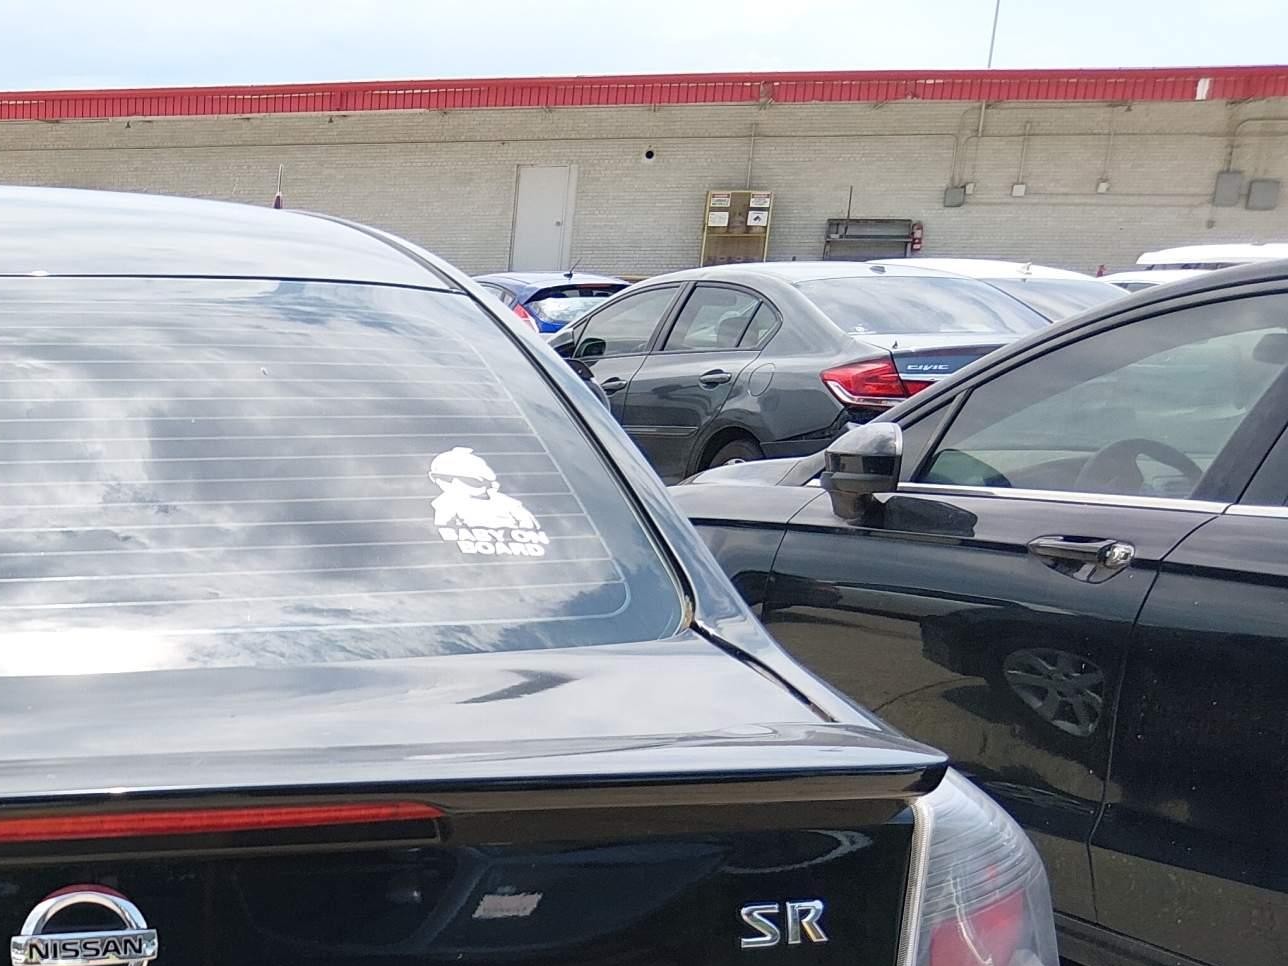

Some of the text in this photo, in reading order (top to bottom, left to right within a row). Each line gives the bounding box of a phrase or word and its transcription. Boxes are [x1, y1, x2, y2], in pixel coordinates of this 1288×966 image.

[438, 527, 550, 545] BABY ON
[456, 541, 545, 557] BOARD
[740, 899, 829, 949] SR
[28, 934, 144, 960] NISSAN
